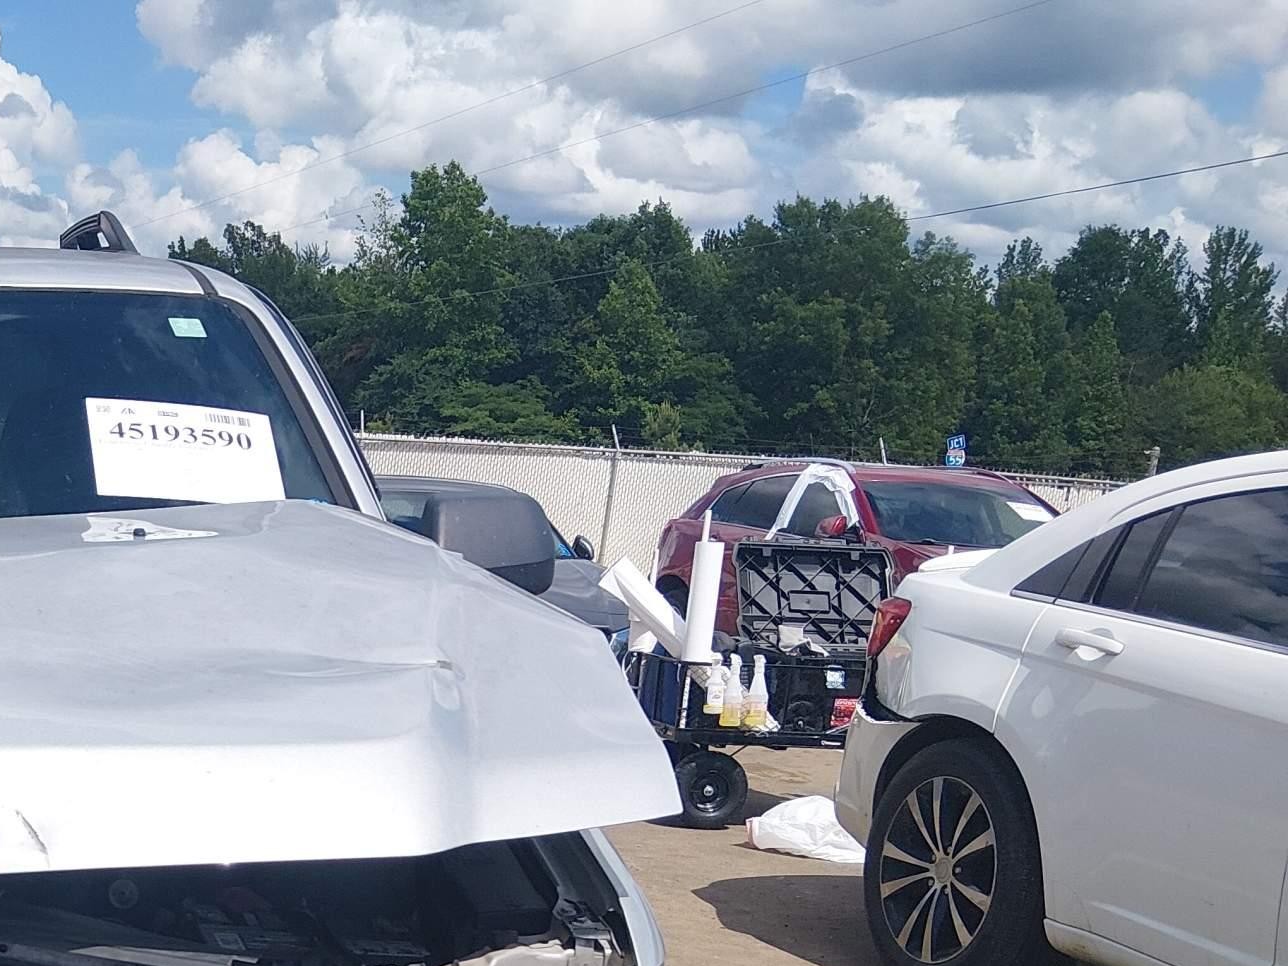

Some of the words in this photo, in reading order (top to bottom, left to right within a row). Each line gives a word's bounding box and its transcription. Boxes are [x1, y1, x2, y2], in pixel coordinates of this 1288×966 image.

[109, 421, 252, 450] 45193590
[950, 437, 963, 449] JCT
[949, 456, 962, 465] 55
